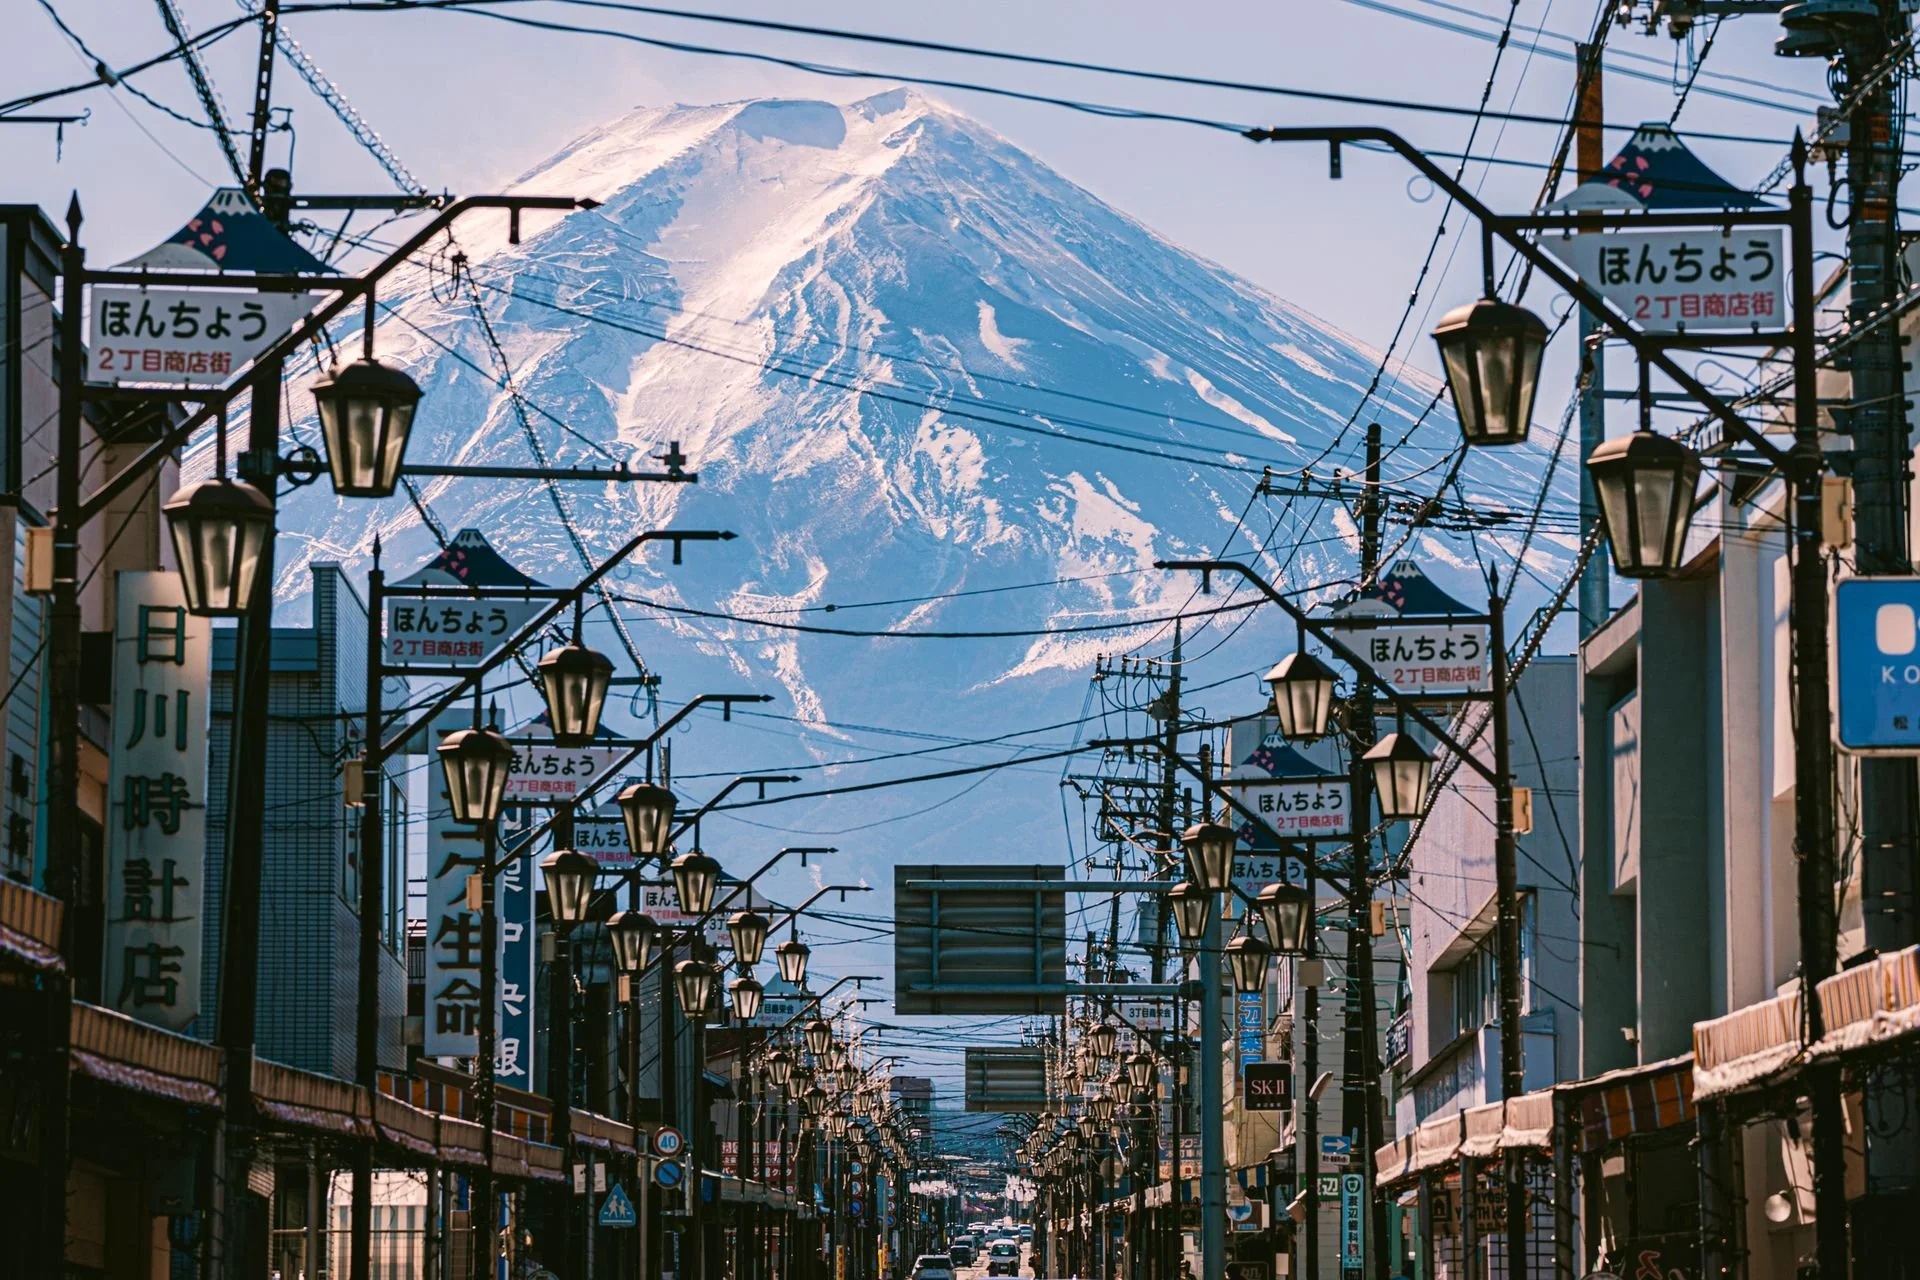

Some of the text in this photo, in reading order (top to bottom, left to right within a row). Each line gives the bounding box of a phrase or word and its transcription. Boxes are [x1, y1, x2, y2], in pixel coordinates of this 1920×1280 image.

[1600, 240, 1775, 285] ほんちょう
[101, 300, 267, 341] ほんちょう
[393, 606, 508, 636] ほんちょう
[1370, 634, 1480, 663] ほんちょう
[118, 603, 190, 1008] 日川時計店
[1258, 789, 1343, 813] ほんちょう
[660, 1135, 678, 1149] 40
